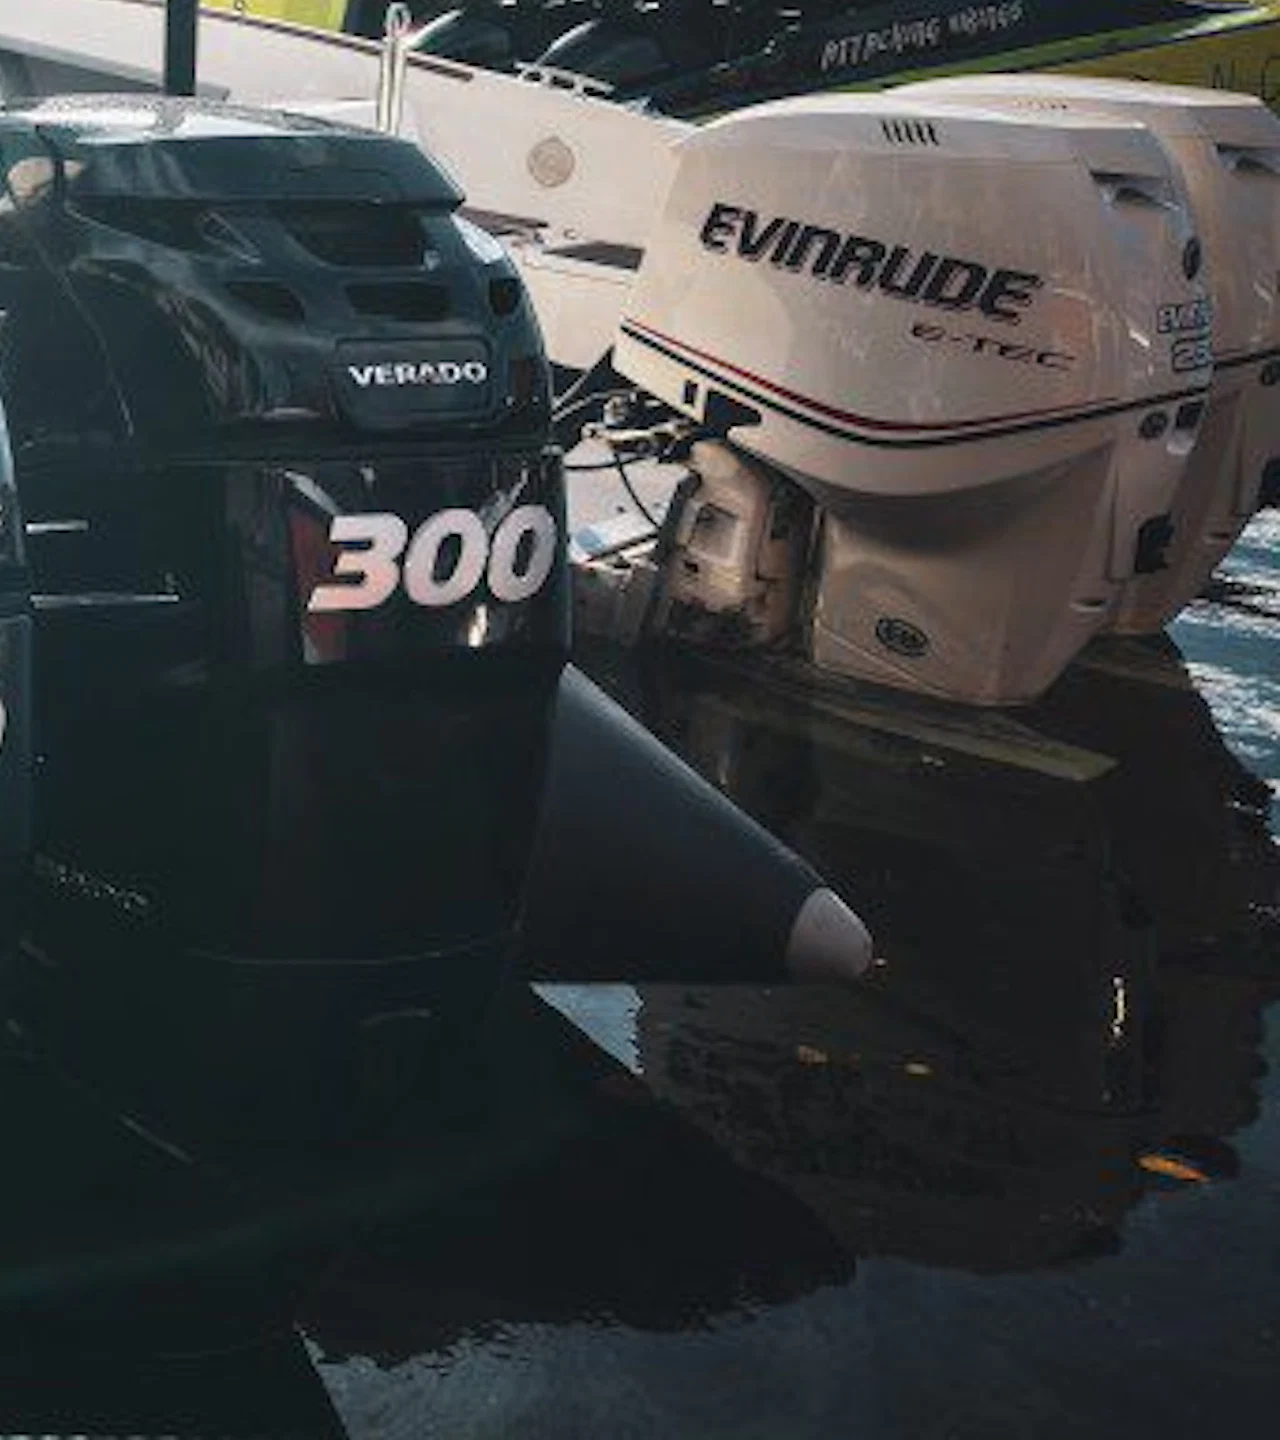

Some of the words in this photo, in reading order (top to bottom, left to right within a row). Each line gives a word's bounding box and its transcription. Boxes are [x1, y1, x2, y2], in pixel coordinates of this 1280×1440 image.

[698, 202, 1045, 327] EVINRUDE
[347, 362, 488, 386] VERADO
[307, 504, 557, 611] 300
